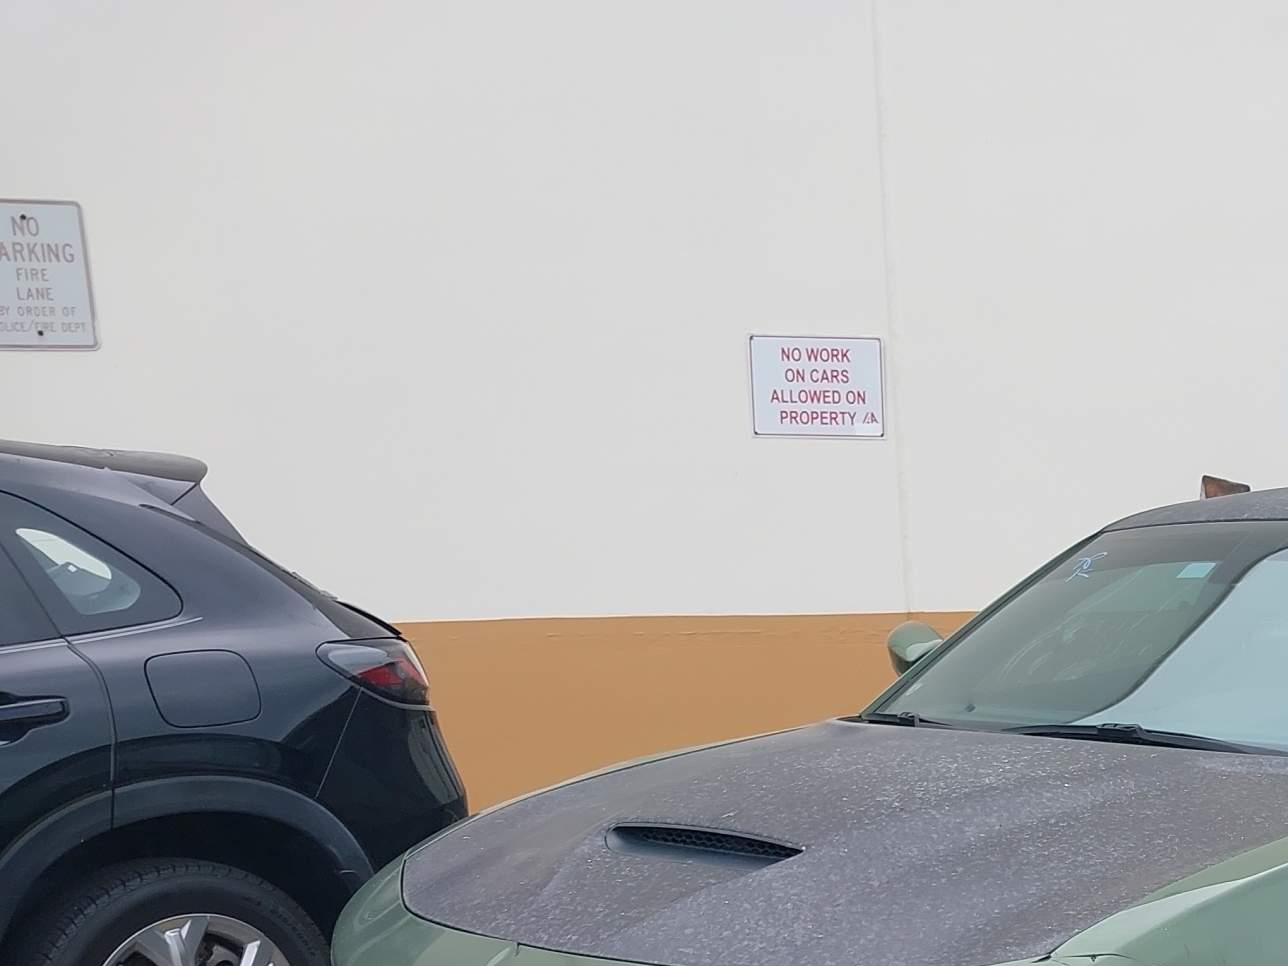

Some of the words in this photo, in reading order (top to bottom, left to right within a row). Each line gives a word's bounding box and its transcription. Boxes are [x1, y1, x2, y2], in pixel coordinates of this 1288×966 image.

[10, 215, 40, 237] NO
[0, 241, 75, 263] ARKING
[16, 267, 49, 281] FIRE
[16, 287, 55, 301] LANE
[17, 305, 57, 317] ORDER
[62, 306, 78, 318] OF
[781, 347, 802, 362] NO
[806, 347, 851, 363] WORK
[785, 368, 805, 383] ON
[810, 369, 850, 384] CARS
[770, 389, 841, 404] ALLOWED
[846, 390, 866, 405] ON
[780, 410, 857, 426] PROPERTY
